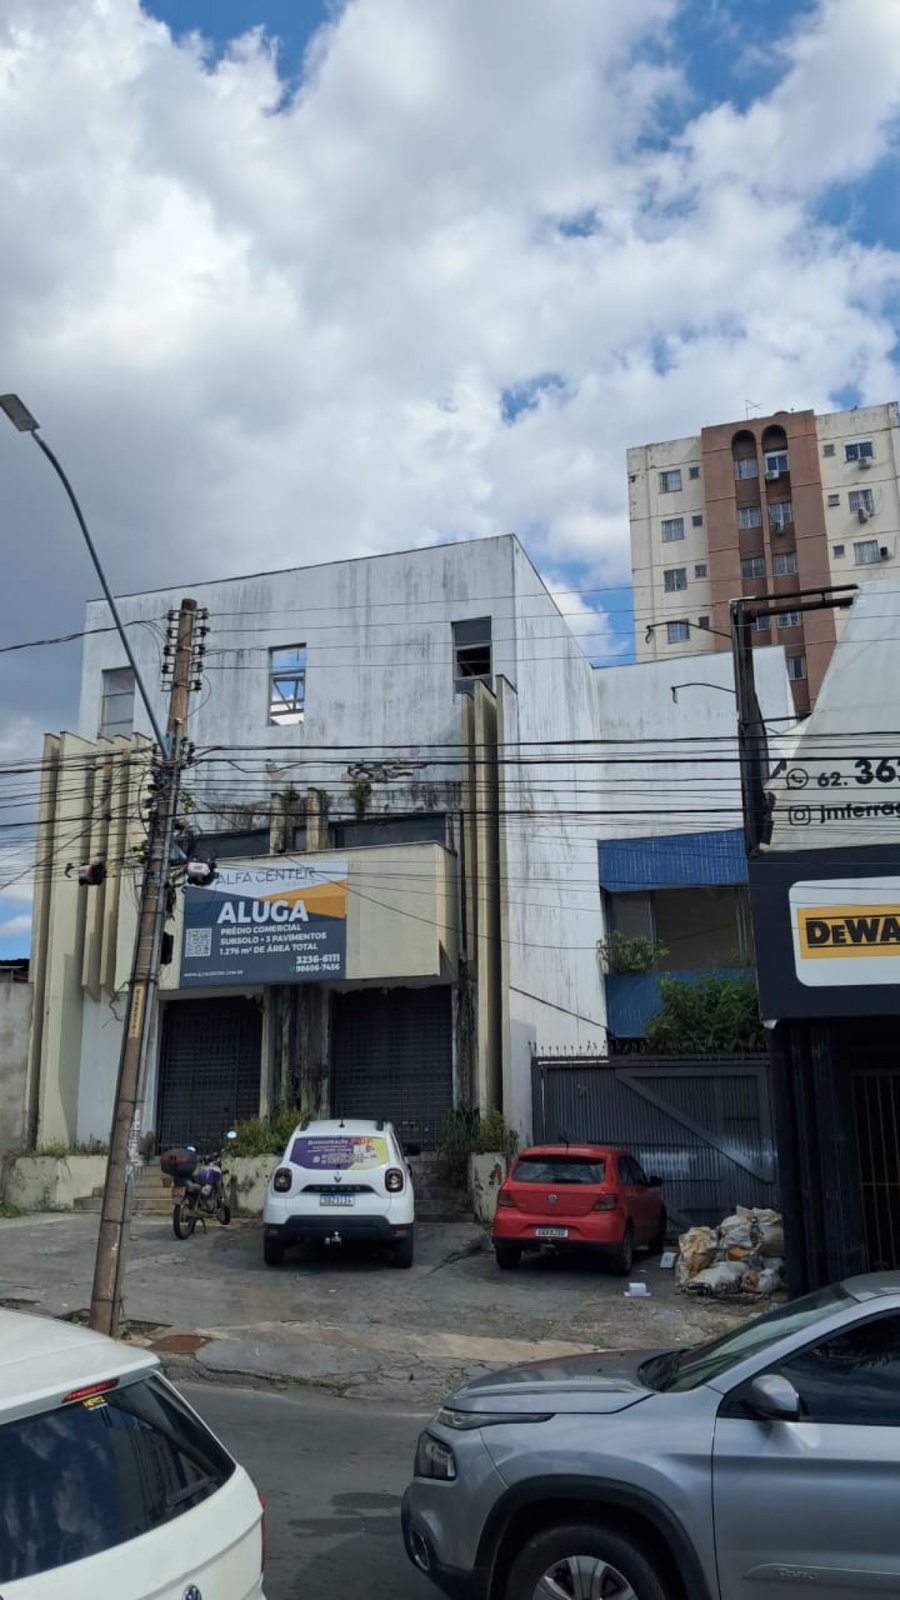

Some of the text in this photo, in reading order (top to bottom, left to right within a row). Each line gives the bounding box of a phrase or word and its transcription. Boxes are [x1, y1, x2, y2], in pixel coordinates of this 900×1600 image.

[817, 758, 900, 787] 62. 36
[820, 802, 900, 823] jmferra
[216, 867, 315, 885] ALFA CENTER
[217, 900, 309, 924] ALUGA
[221, 923, 302, 936] PRÉDIO COMERCIAL
[220, 936, 259, 946] SUBSOLO
[272, 932, 327, 942] PAVIMENTOS
[266, 943, 290, 952] ÁREA
[292, 943, 318, 951] TOTAL
